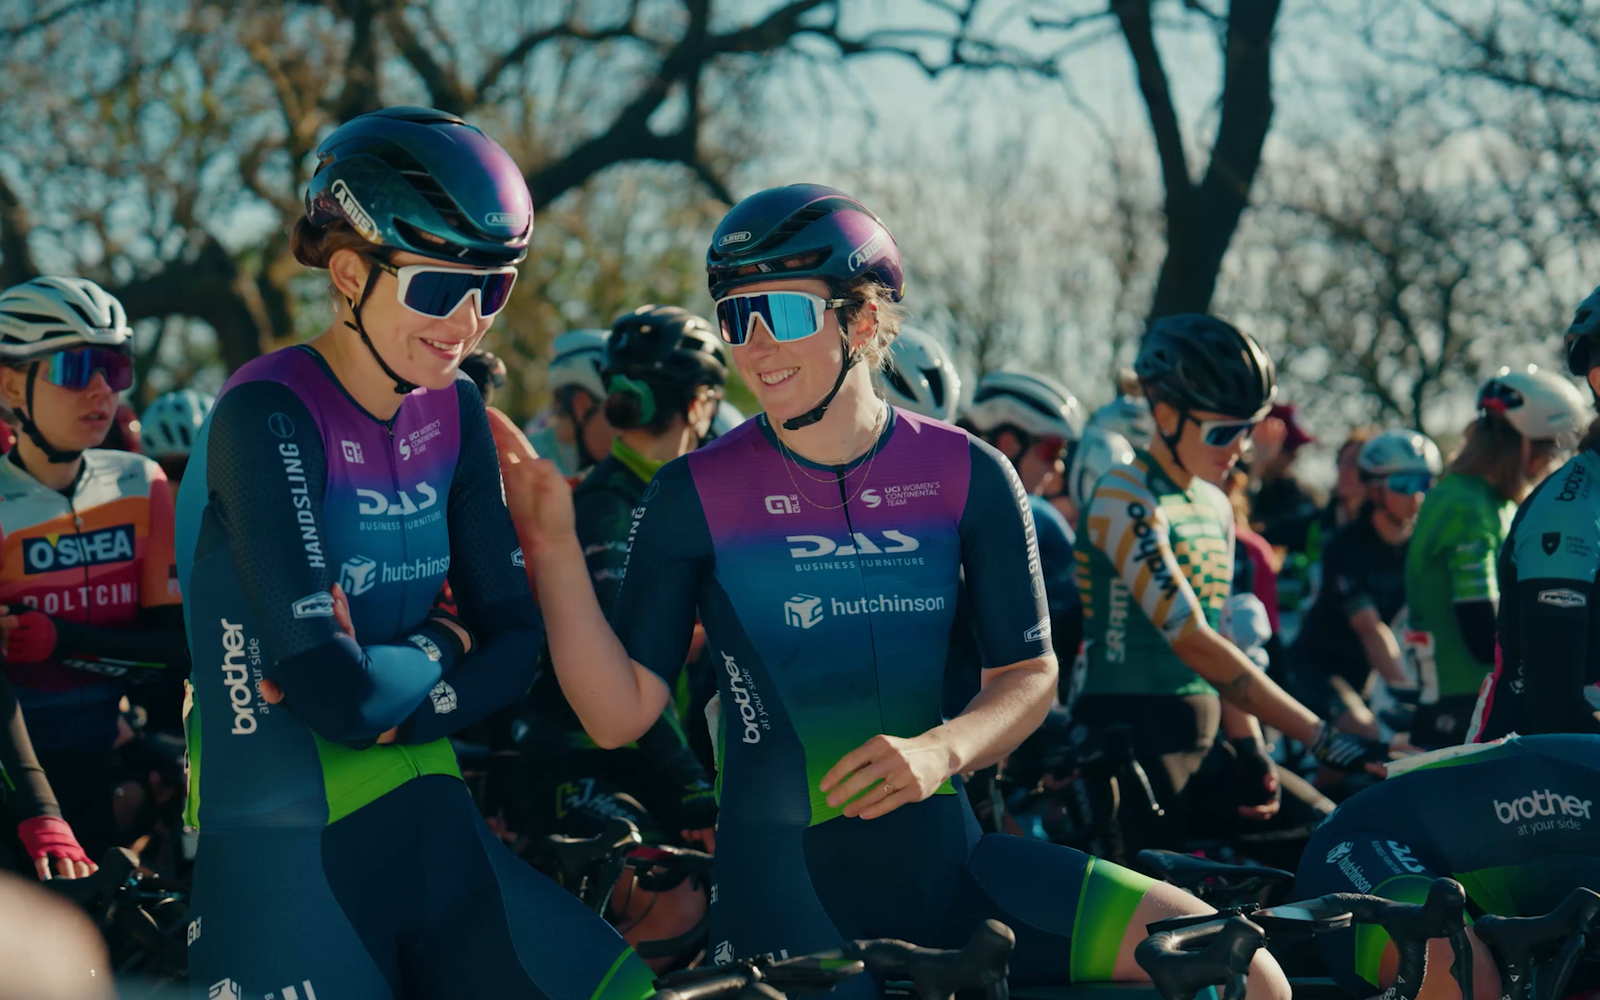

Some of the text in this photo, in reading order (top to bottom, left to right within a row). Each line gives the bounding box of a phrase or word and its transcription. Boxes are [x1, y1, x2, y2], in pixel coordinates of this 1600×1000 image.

[335, 187, 372, 235] ABUS
[722, 233, 747, 244] ABUS
[856, 238, 883, 267] ABUS
[356, 481, 438, 516] DAS
[884, 481, 941, 494] UCI WOMEN'S
[885, 488, 938, 501] CONTINENTAL
[278, 442, 326, 569] HANDSLING
[886, 498, 908, 507] TEAM
[359, 521, 401, 532] BUSINESS
[785, 530, 920, 559] DAS
[795, 557, 925, 572] BUSINESS FURNITURE
[831, 594, 945, 616] hutchinson
[247, 637, 262, 666] side
[221, 618, 258, 735] brother
[257, 700, 270, 715] at
[720, 650, 761, 744] brother
[741, 668, 771, 731] at your side
[1493, 788, 1593, 825] brother
[1517, 816, 1582, 837] at your side
[1337, 853, 1373, 895] hutchinson
